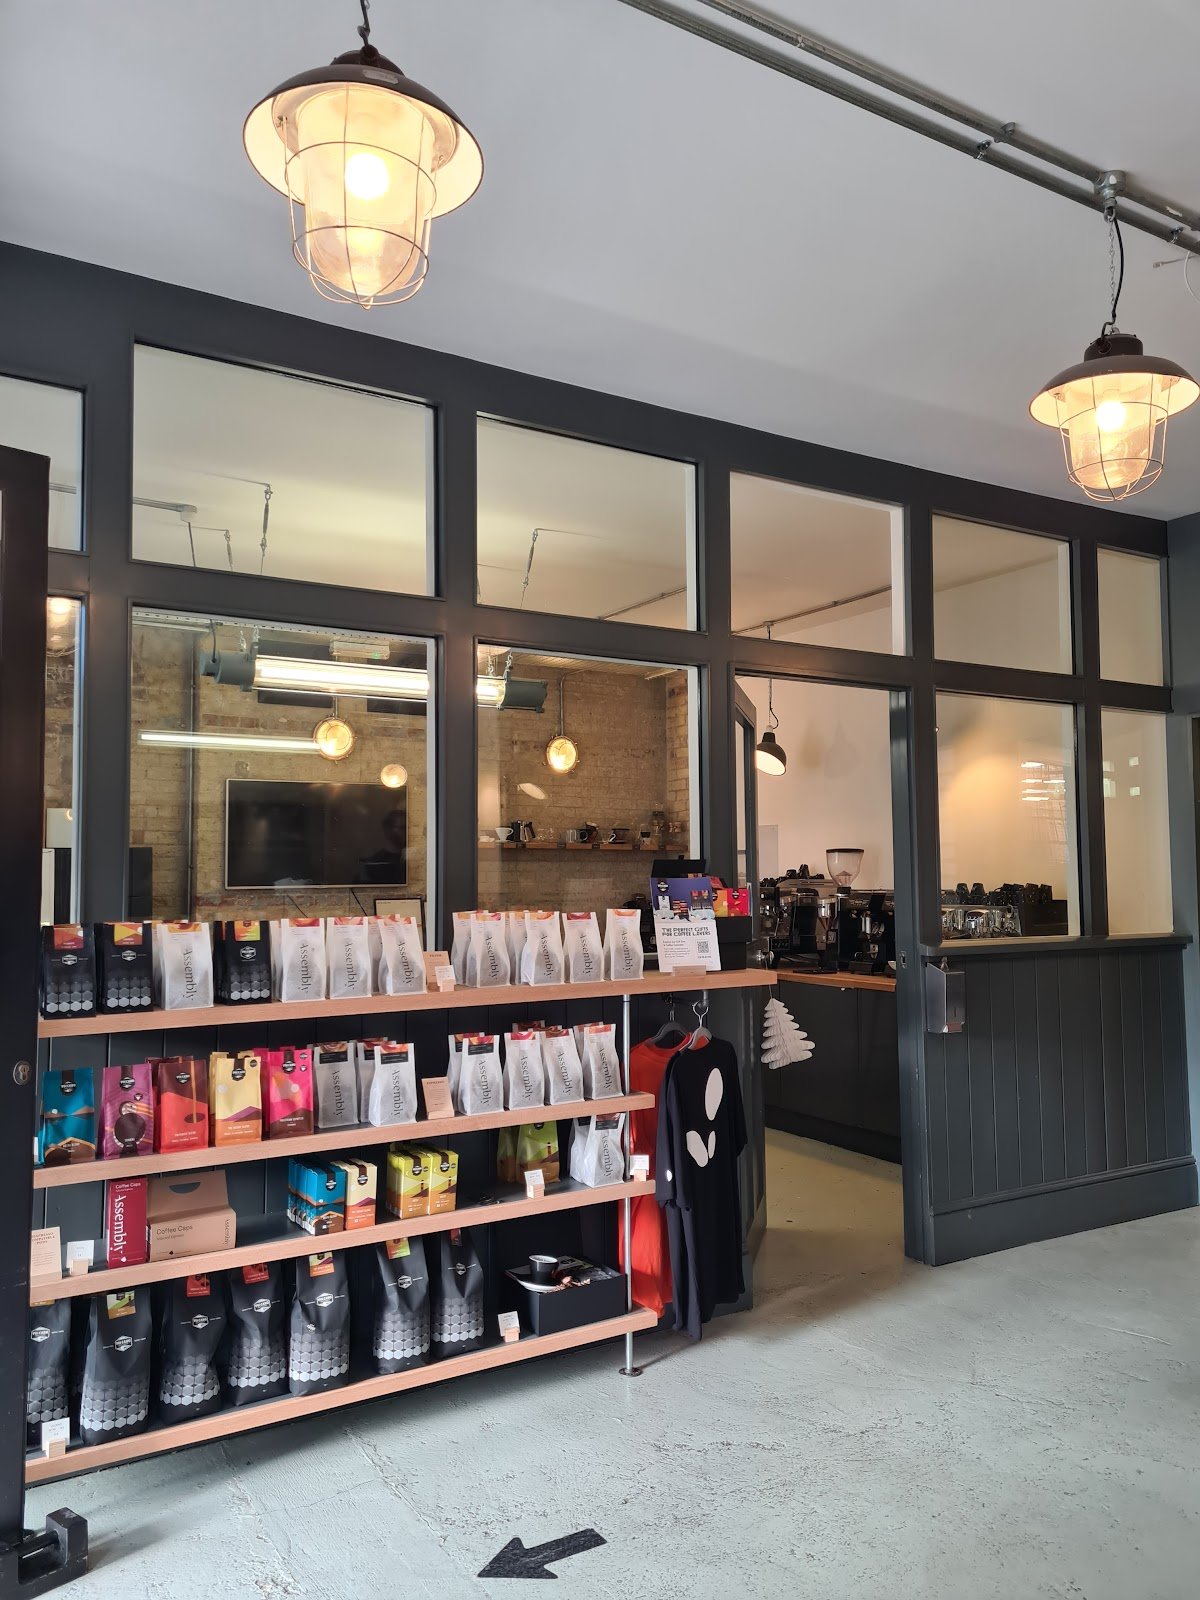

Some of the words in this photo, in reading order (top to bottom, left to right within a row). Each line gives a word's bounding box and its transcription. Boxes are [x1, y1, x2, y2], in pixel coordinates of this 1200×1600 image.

[183, 949, 197, 1000] Assembly
[298, 943, 311, 993] Assembly
[344, 942, 357, 990] Assembly
[398, 941, 414, 986] Assembly
[485, 936, 499, 979] Assembly
[540, 934, 554, 978] Assembly
[579, 934, 593, 976] Assembly
[620, 931, 633, 973] Assembly
[477, 1059, 491, 1106] Assembly
[519, 1055, 534, 1100] Assembly
[558, 1051, 573, 1095] Assembly
[599, 1048, 613, 1089] Assembly
[332, 1070, 345, 1117] Assembly
[391, 1070, 403, 1117] Assembly
[601, 1133, 613, 1177] Assembly
[110, 1195, 127, 1253] Assembly
[156, 1227, 176, 1235] Coffee
